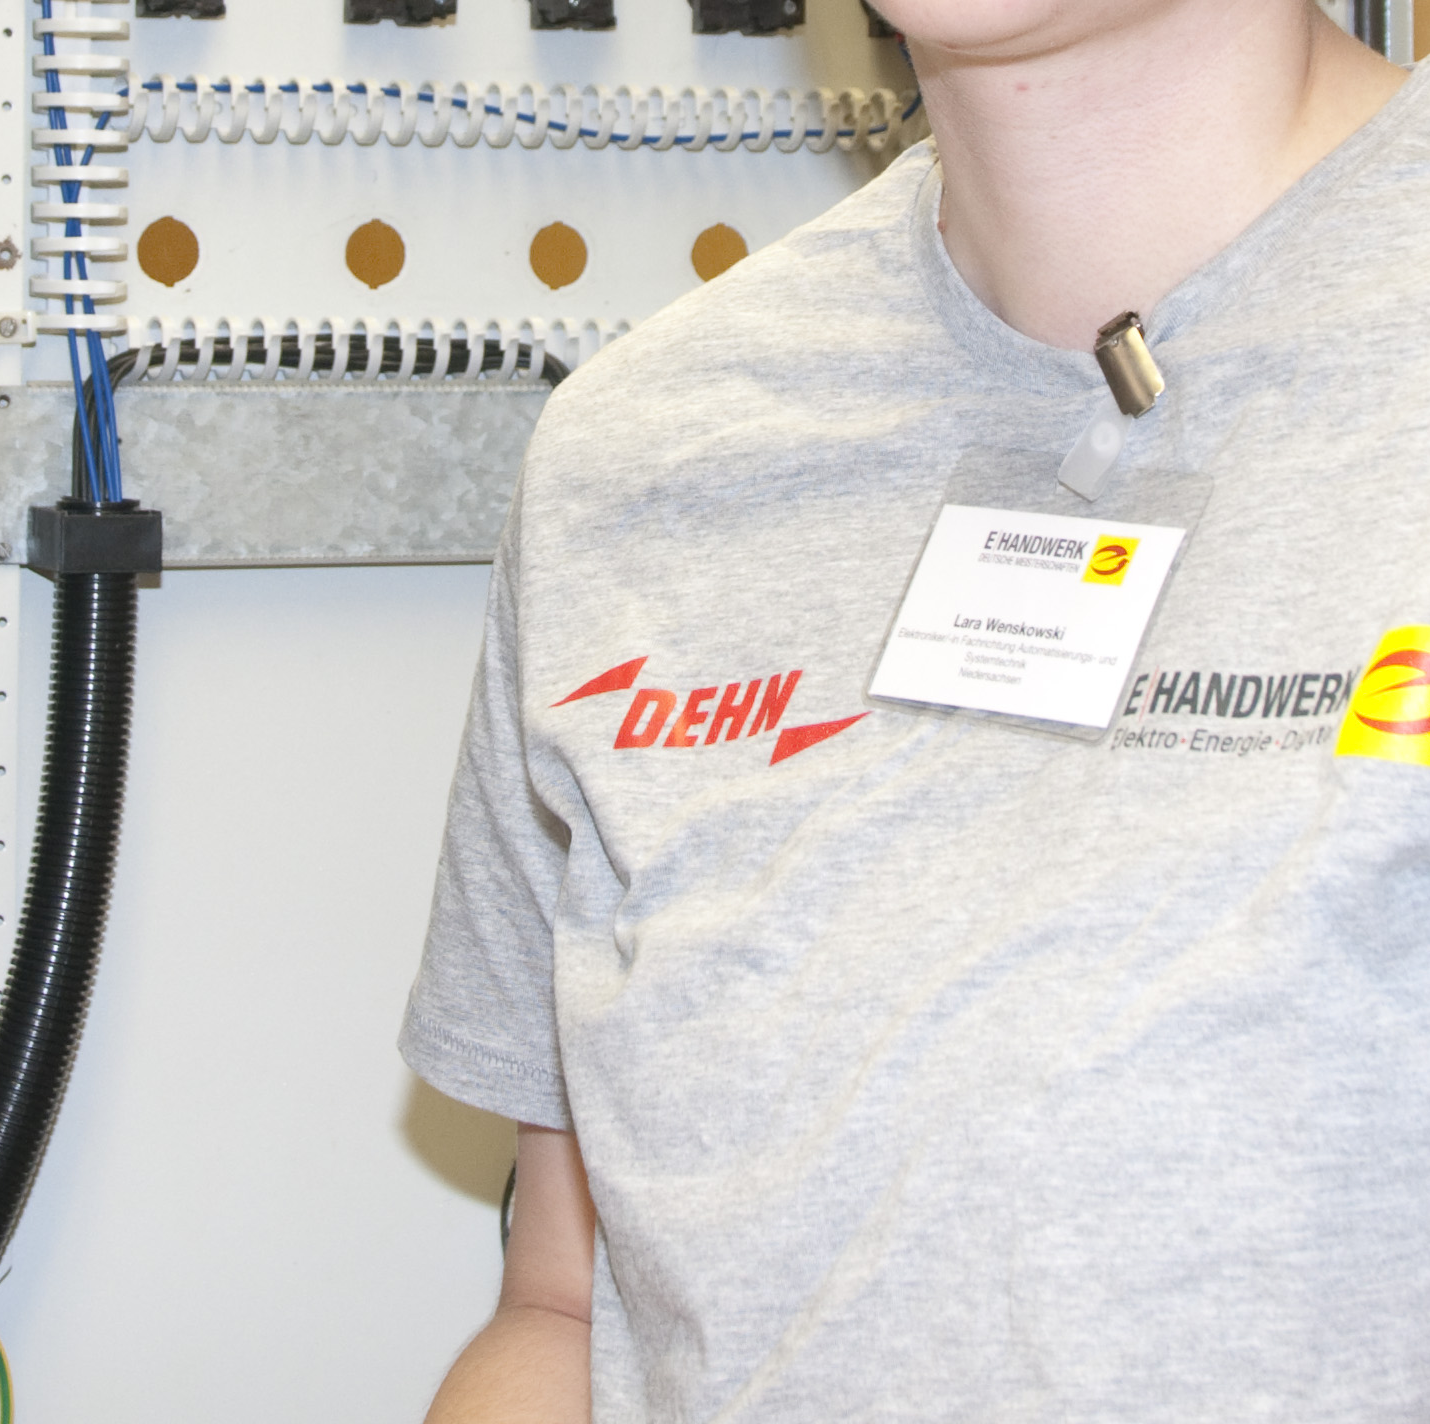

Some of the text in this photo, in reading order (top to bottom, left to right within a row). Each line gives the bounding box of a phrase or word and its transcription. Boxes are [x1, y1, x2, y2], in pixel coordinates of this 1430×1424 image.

[984, 531, 1089, 560] E HANDWERK
[953, 614, 1066, 641] Lara Wenskowski
[961, 635, 1016, 654] Fachrichtung
[1098, 655, 1119, 667] und
[958, 666, 1022, 685] Niedersachsen
[613, 669, 803, 749] DEHN
[1123, 673, 1149, 716] E
[1110, 727, 1178, 751] Elektro
[1189, 728, 1272, 757] Energie
